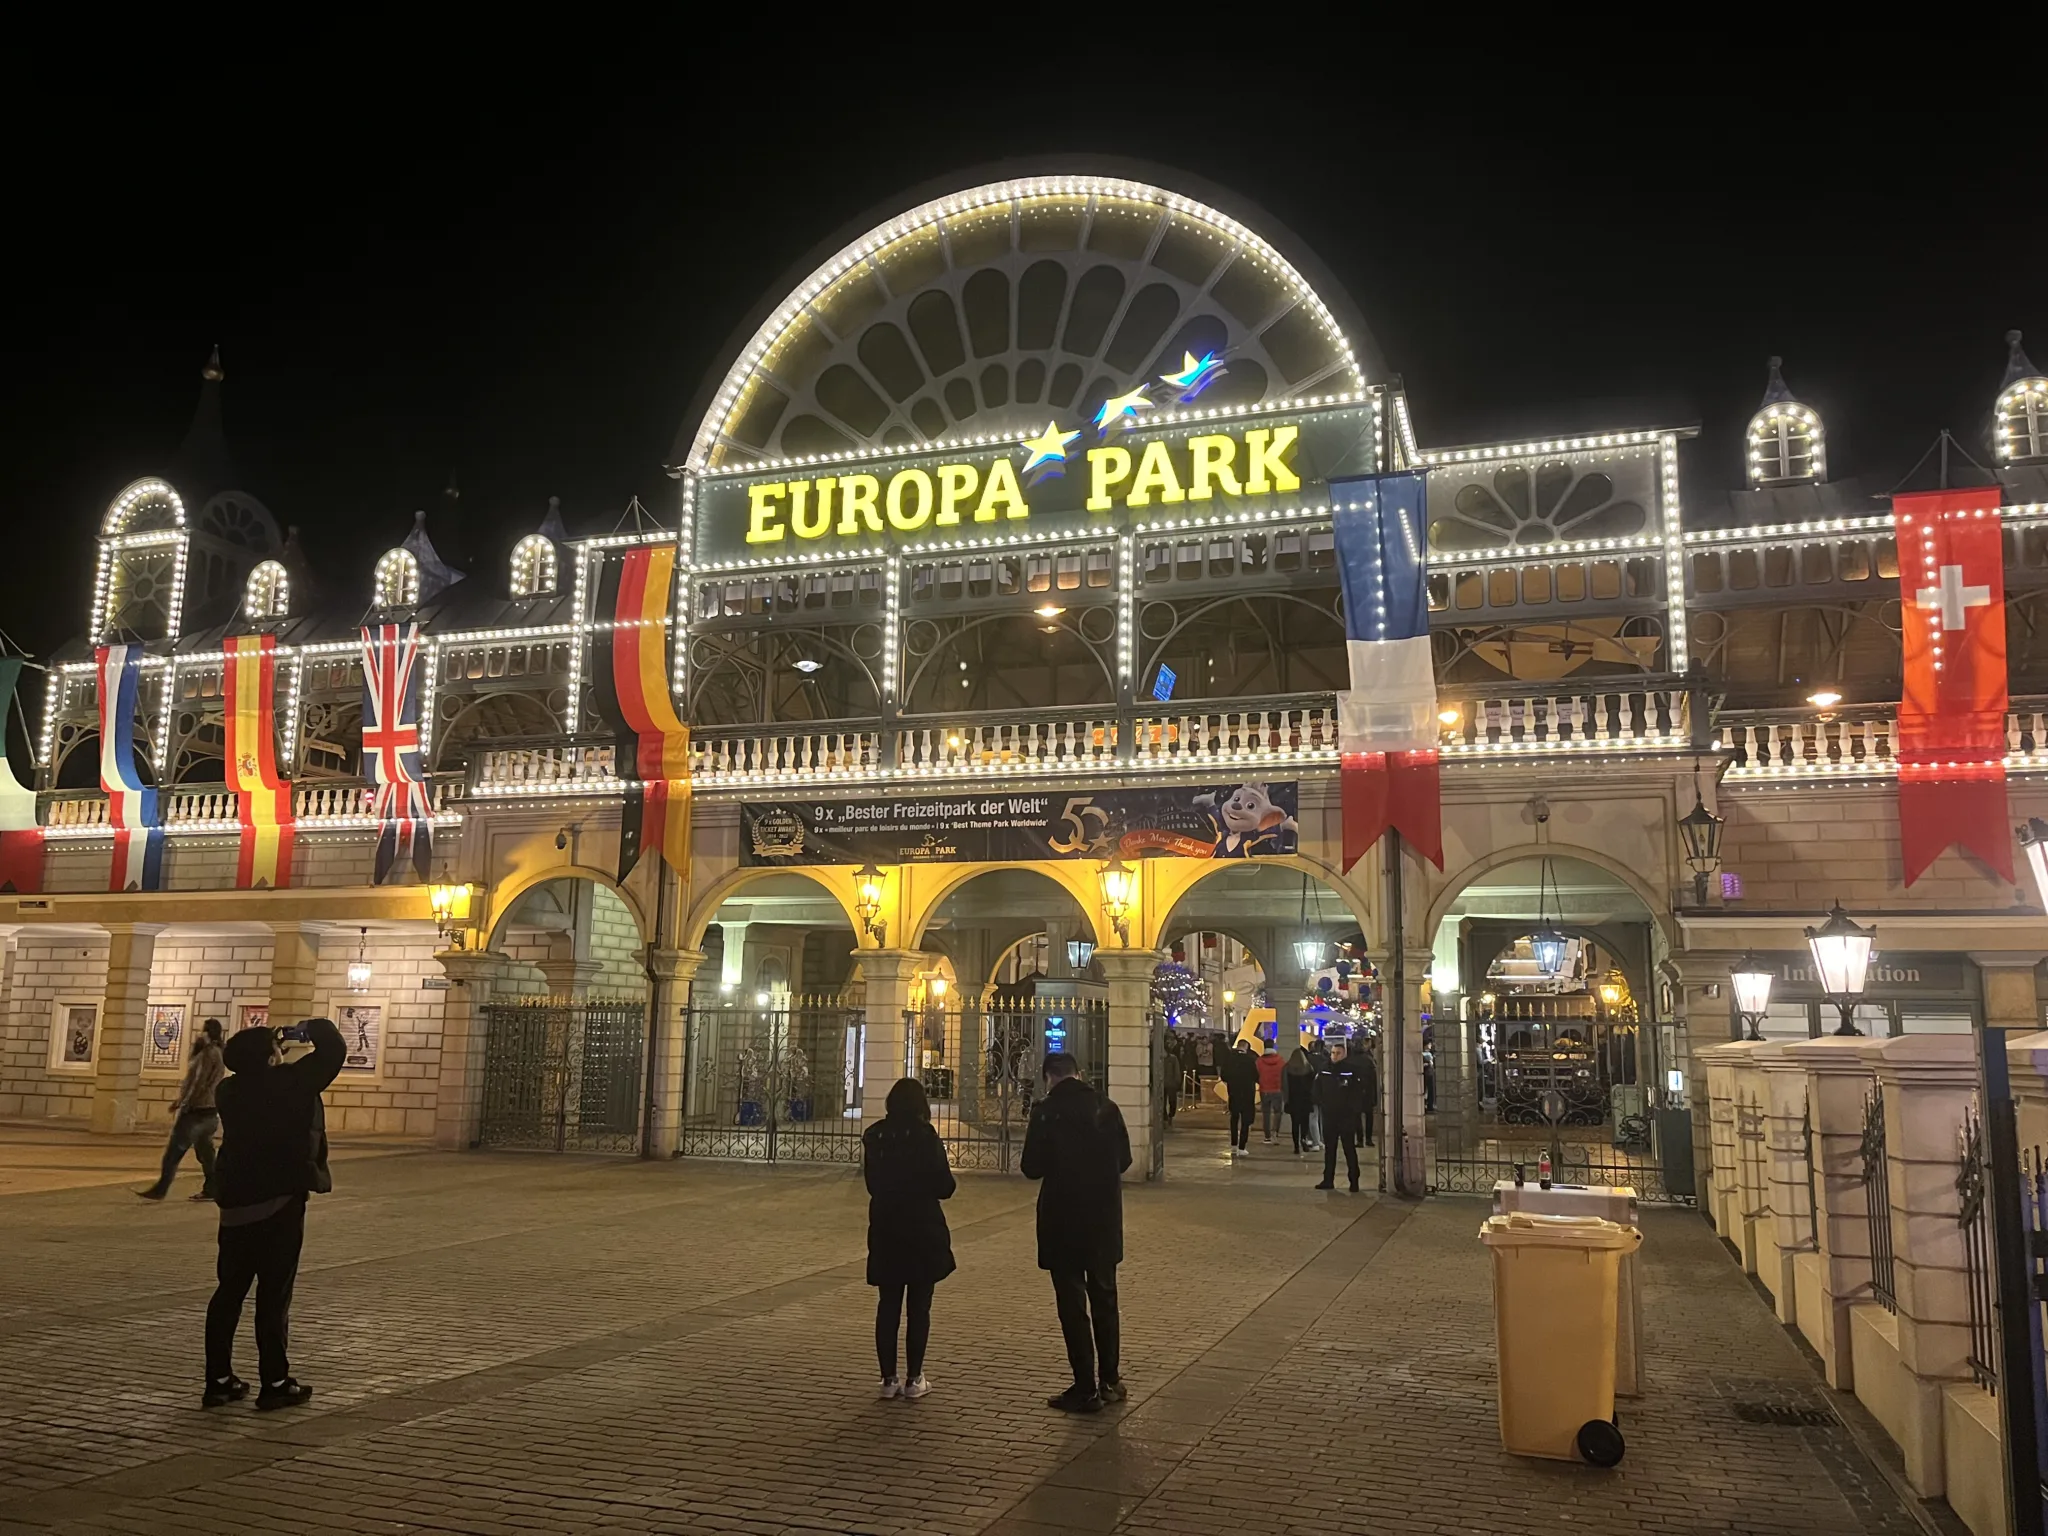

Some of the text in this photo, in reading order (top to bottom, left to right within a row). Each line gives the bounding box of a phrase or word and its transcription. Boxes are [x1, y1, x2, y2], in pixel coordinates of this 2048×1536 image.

[746, 425, 1300, 543] EUROPA PARK
[893, 800, 976, 819] Freizeitpark
[980, 800, 1005, 815] der
[855, 826, 869, 834] parc
[970, 820, 992, 829] Theme
[993, 819, 1009, 828] Park
[900, 846, 957, 855] EUROPA PARK
[1149, 832, 1172, 844] Merci
[1174, 838, 1194, 852] Thank
[1194, 848, 1208, 856] you
[1783, 964, 1920, 982] Infation
